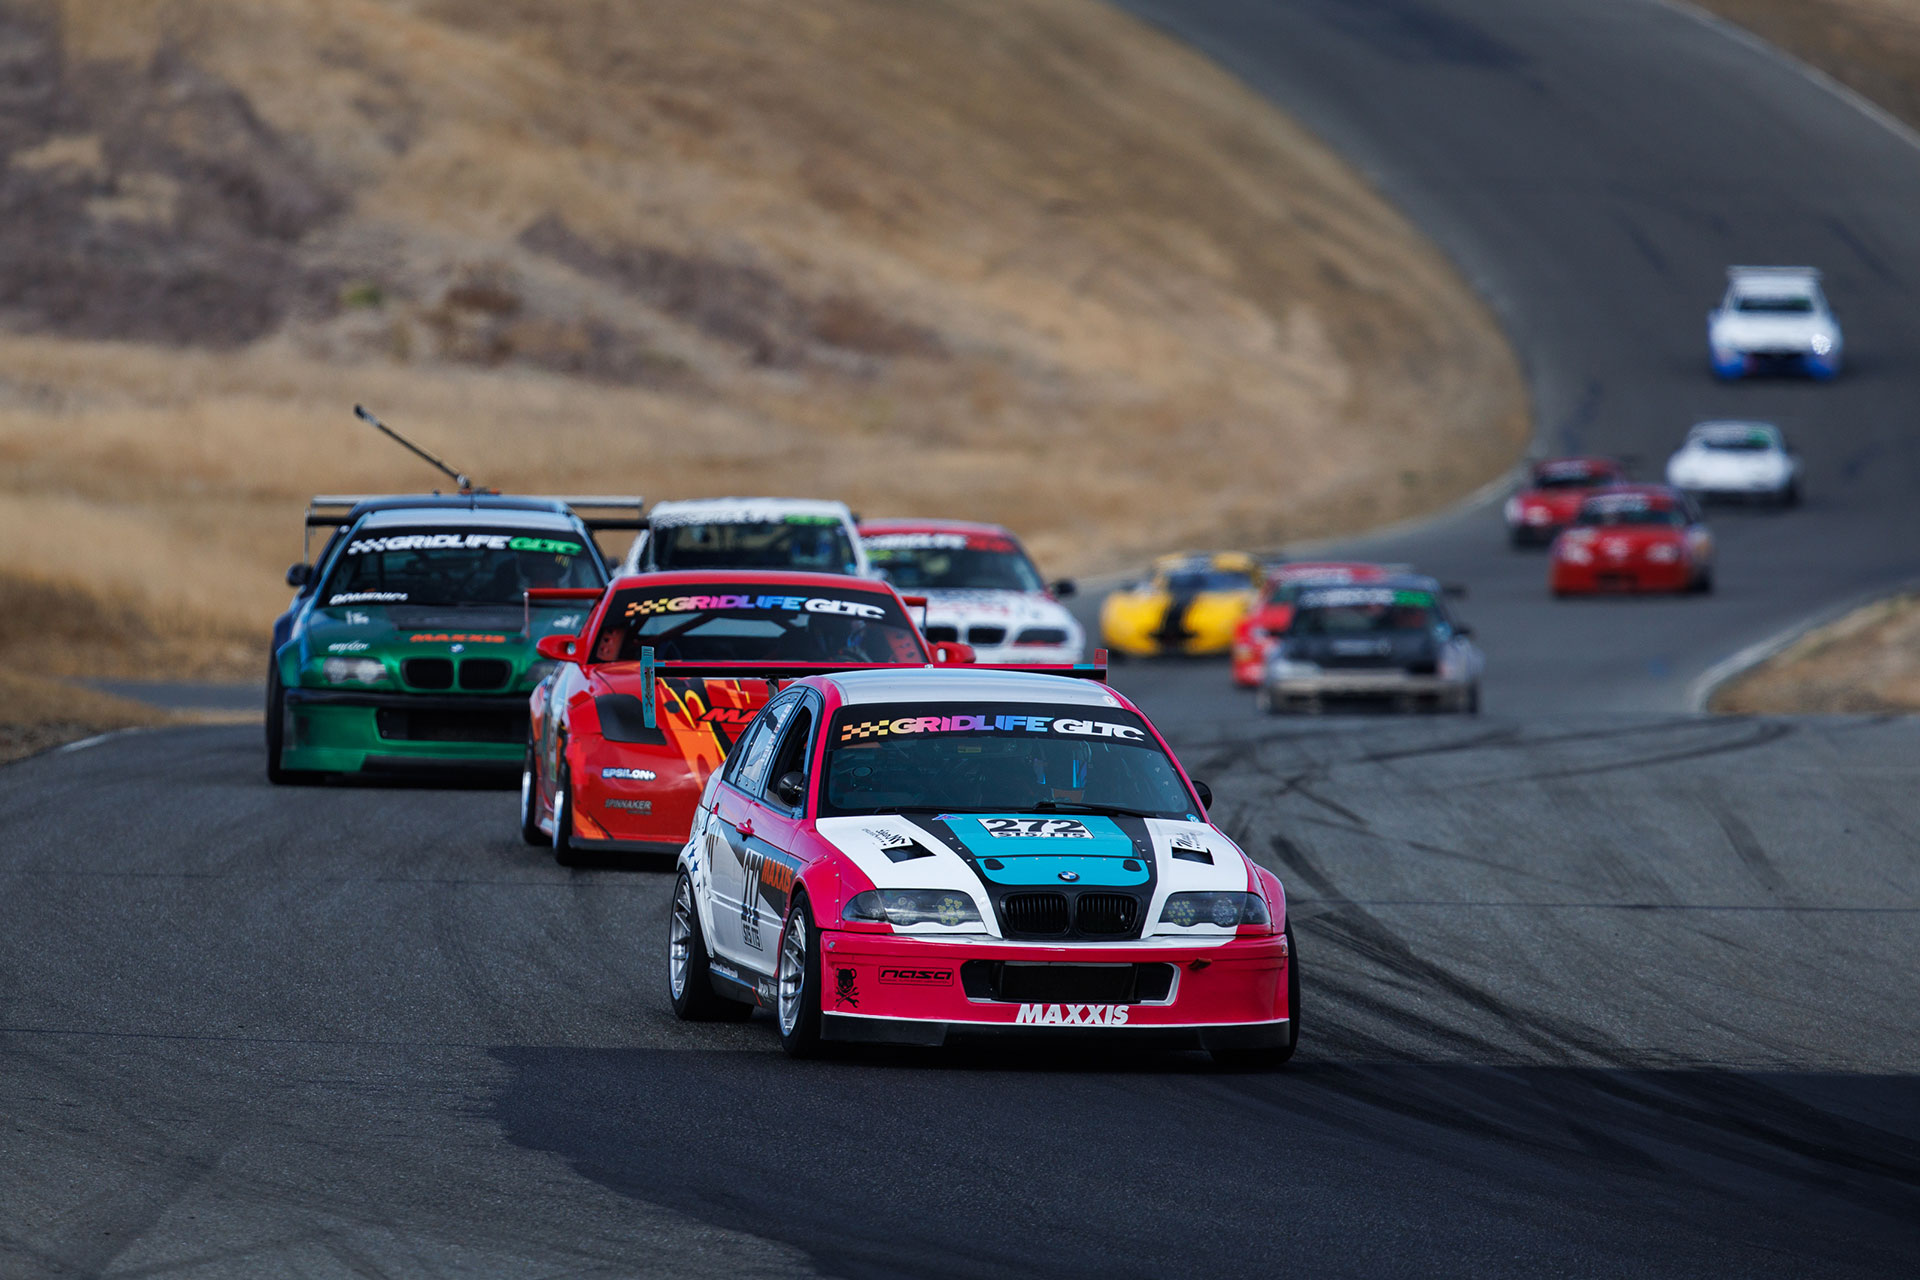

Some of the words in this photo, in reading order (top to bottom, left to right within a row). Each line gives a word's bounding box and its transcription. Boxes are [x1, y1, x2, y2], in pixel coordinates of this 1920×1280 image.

[385, 534, 512, 551] GRIDLIFE
[508, 537, 582, 555] GLTC
[666, 595, 809, 612] GRIDLIFE
[805, 598, 886, 620] GLTC
[889, 715, 1054, 734] GRIDLIFE
[1052, 718, 1145, 741] GLTC
[985, 819, 1086, 833] 272
[761, 856, 794, 893] MAXXIS
[881, 969, 952, 980] nasa
[1015, 1003, 1129, 1025] MAXXIS
